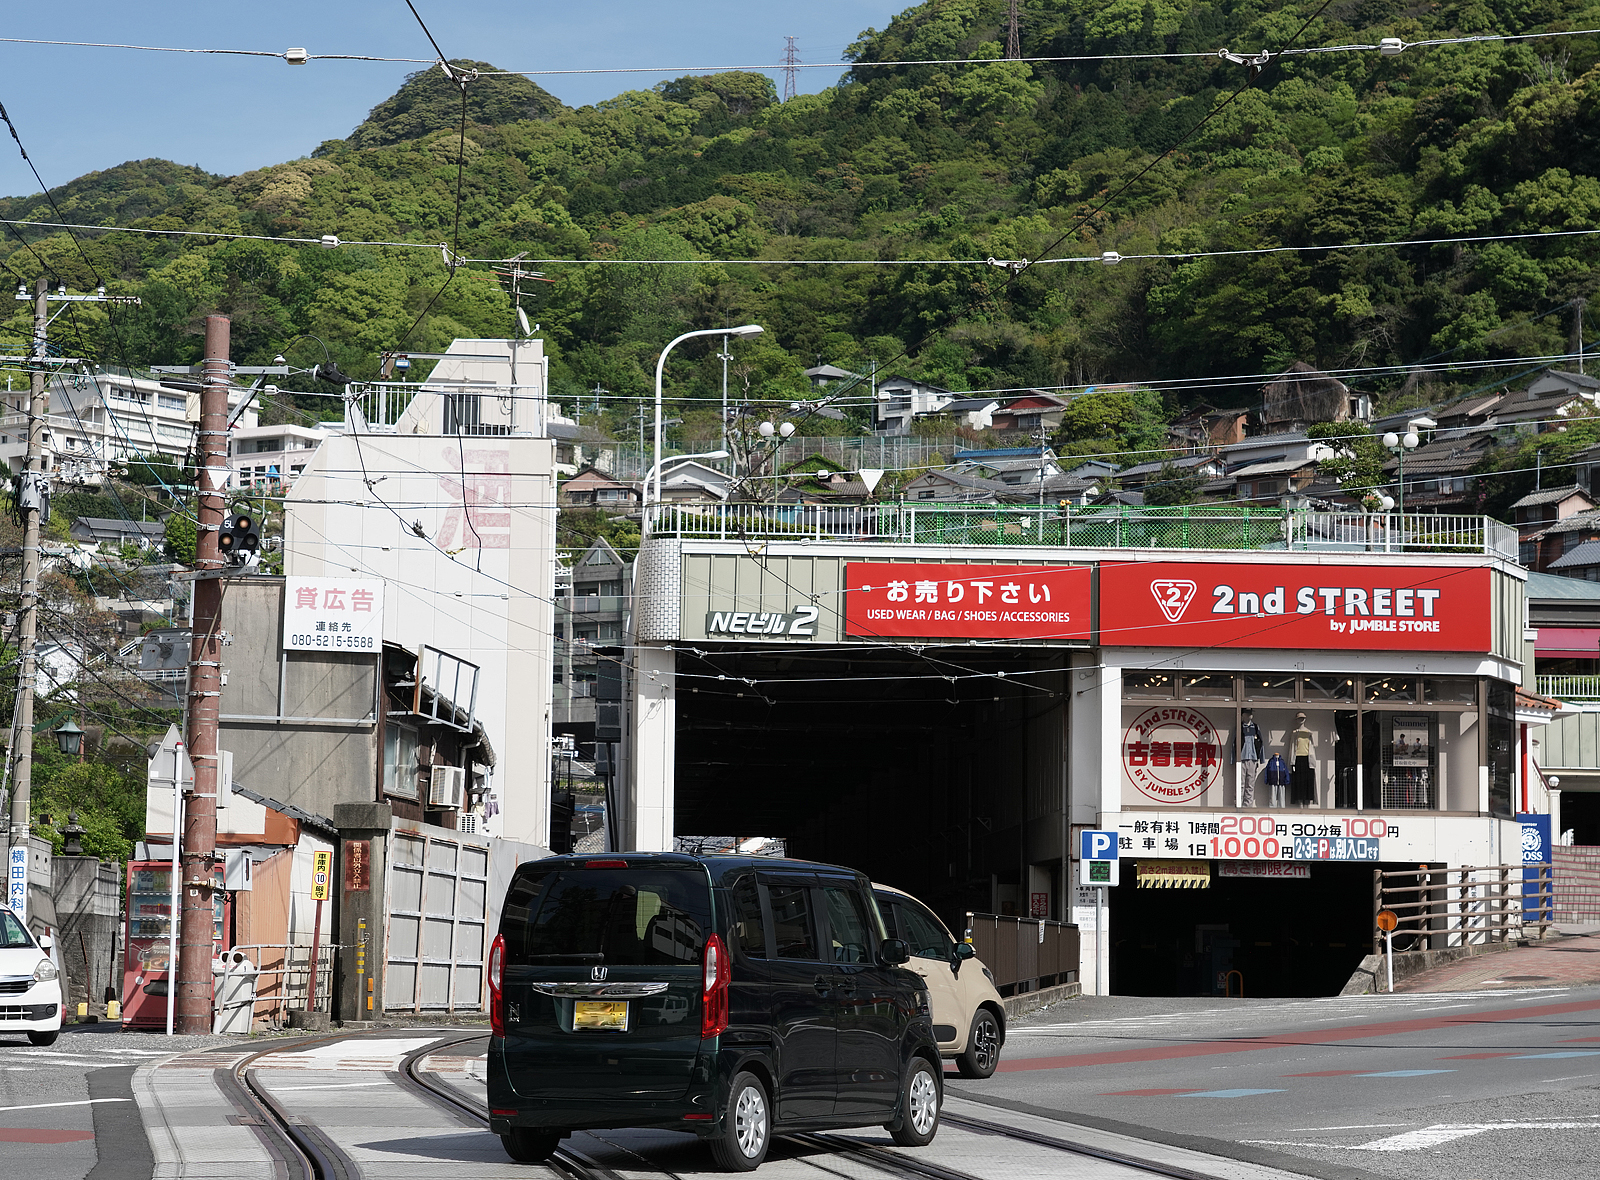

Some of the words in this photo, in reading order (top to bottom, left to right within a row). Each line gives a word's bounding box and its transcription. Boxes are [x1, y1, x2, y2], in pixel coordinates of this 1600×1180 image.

[223, 519, 235, 529] 5L
[886, 579, 1052, 604] お売り下さい
[294, 586, 374, 613] 貸広告
[1211, 585, 1286, 615] 2nd
[1296, 586, 1441, 617] STREET
[867, 609, 894, 620] USED
[896, 609, 925, 620] WEAR
[934, 610, 956, 621] BAG
[964, 610, 998, 622] SHOES
[315, 621, 352, 633] 連絡先
[1330, 620, 1347, 634] by
[1349, 619, 1397, 634] JUMBLE
[1398, 620, 1441, 633] STORE
[291, 634, 374, 649] 080-5215-5588
[1135, 711, 1161, 736] 2nd
[1162, 708, 1211, 736] STREET
[1393, 717, 1428, 728] Summer
[1127, 741, 1217, 768] 古着買取
[1134, 768, 1148, 782] BY
[1145, 781, 1184, 797] JUMBLE
[1184, 769, 1211, 794] STORE
[1118, 820, 1180, 834] 一般有料
[1091, 833, 1111, 859] P
[1118, 837, 1179, 851] 駐車場
[1522, 851, 1543, 861] OSS
[1139, 865, 1208, 876] 高さ2m超進入禁止
[1223, 861, 1307, 877] 高さ制限2m
[10, 849, 26, 912] 横田内科
[317, 874, 325, 883] 10
